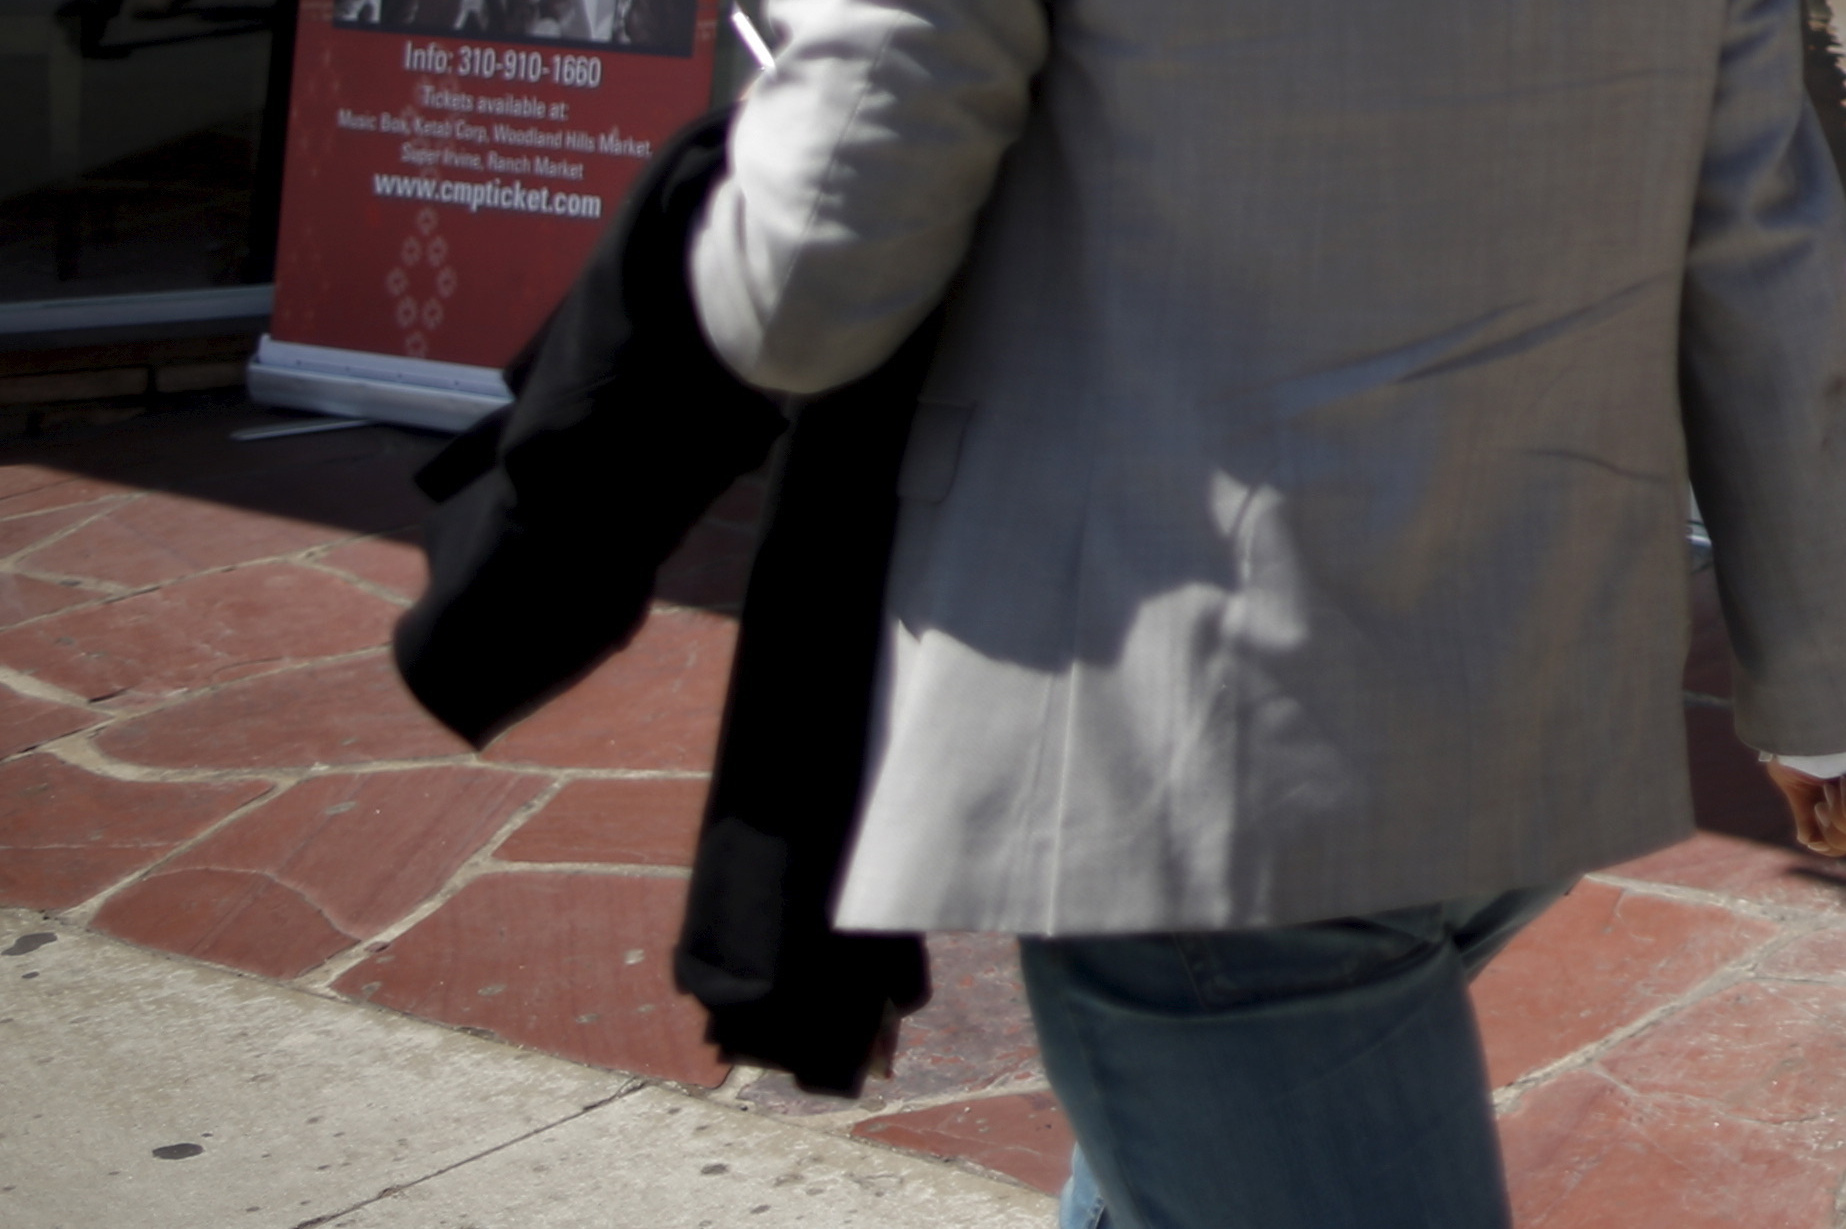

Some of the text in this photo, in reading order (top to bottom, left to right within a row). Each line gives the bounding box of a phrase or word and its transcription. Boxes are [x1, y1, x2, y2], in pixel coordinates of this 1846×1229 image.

[404, 40, 602, 89] Info: 310-910-1660
[421, 84, 570, 121] Tickets available at:
[336, 109, 377, 131] Music
[493, 124, 563, 148] Woodland
[566, 131, 595, 153] Hills
[486, 151, 531, 173] Ranch
[534, 157, 585, 181] Market
[374, 172, 602, 219] www.cmpticket.com
